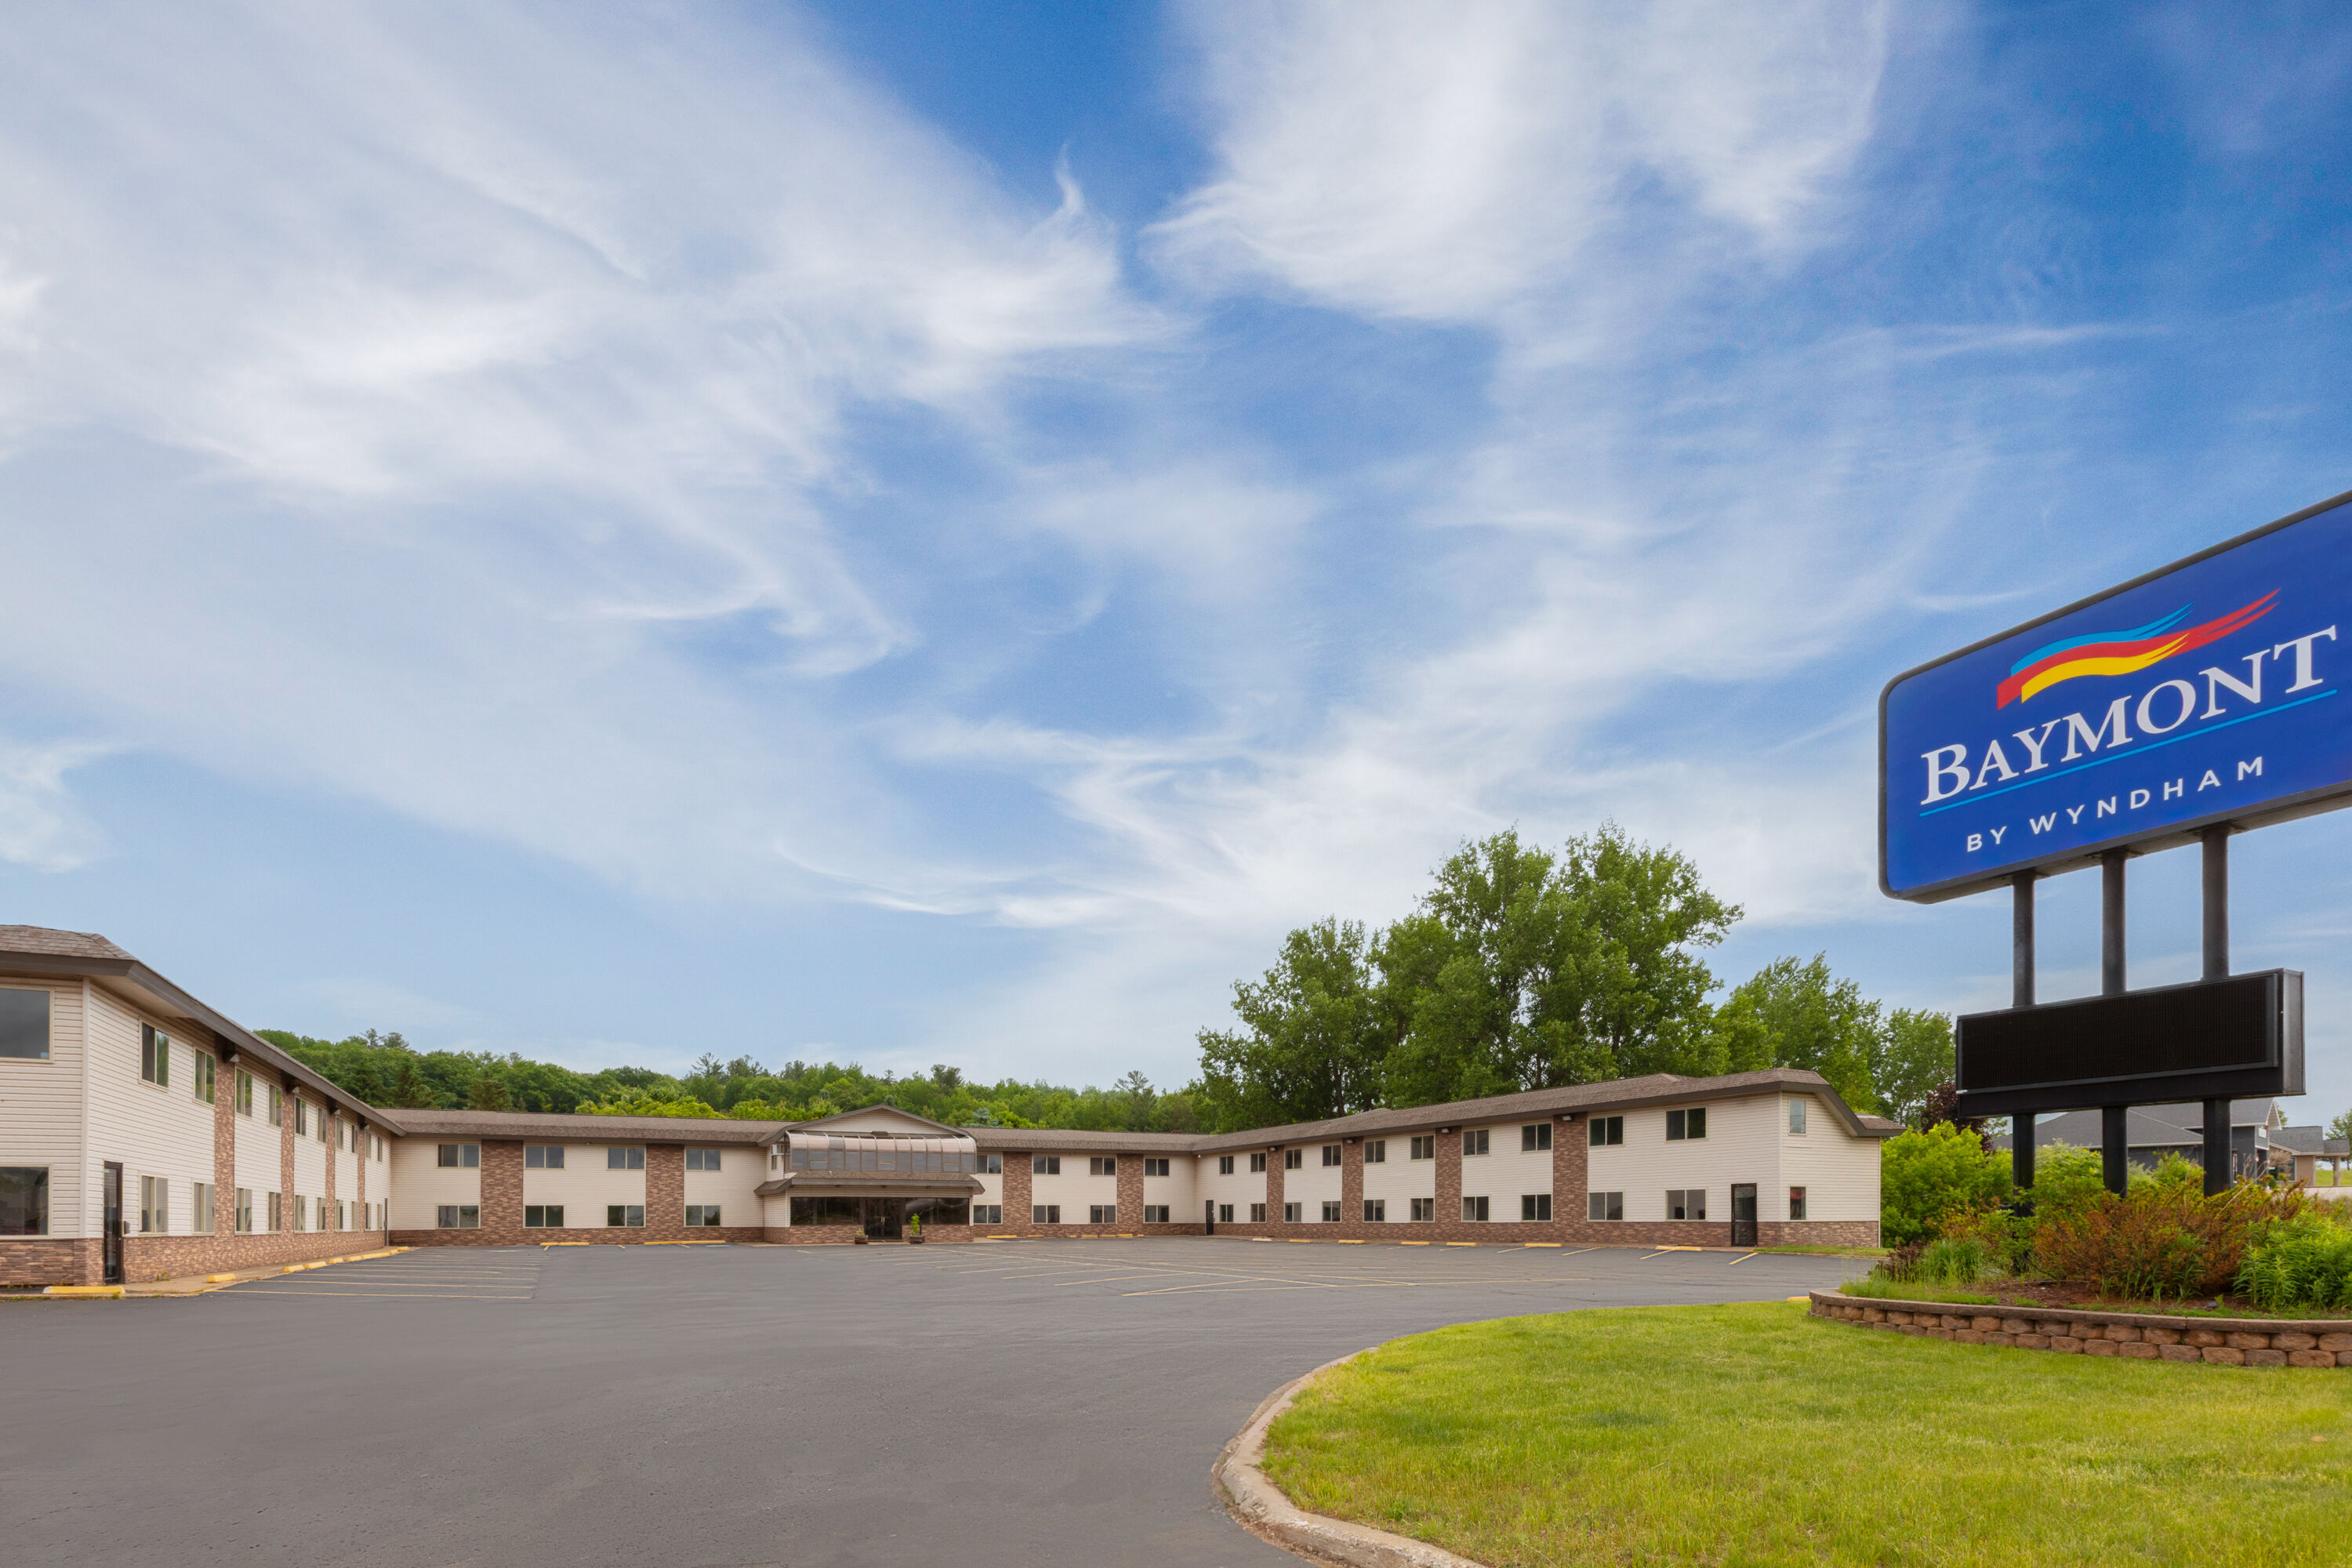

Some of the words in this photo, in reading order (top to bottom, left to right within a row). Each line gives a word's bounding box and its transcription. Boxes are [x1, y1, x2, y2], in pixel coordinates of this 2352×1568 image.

[1920, 624, 2337, 805] BAYMONT
[1966, 826, 2008, 852] BY
[2029, 756, 2263, 835] WYNDHAM
